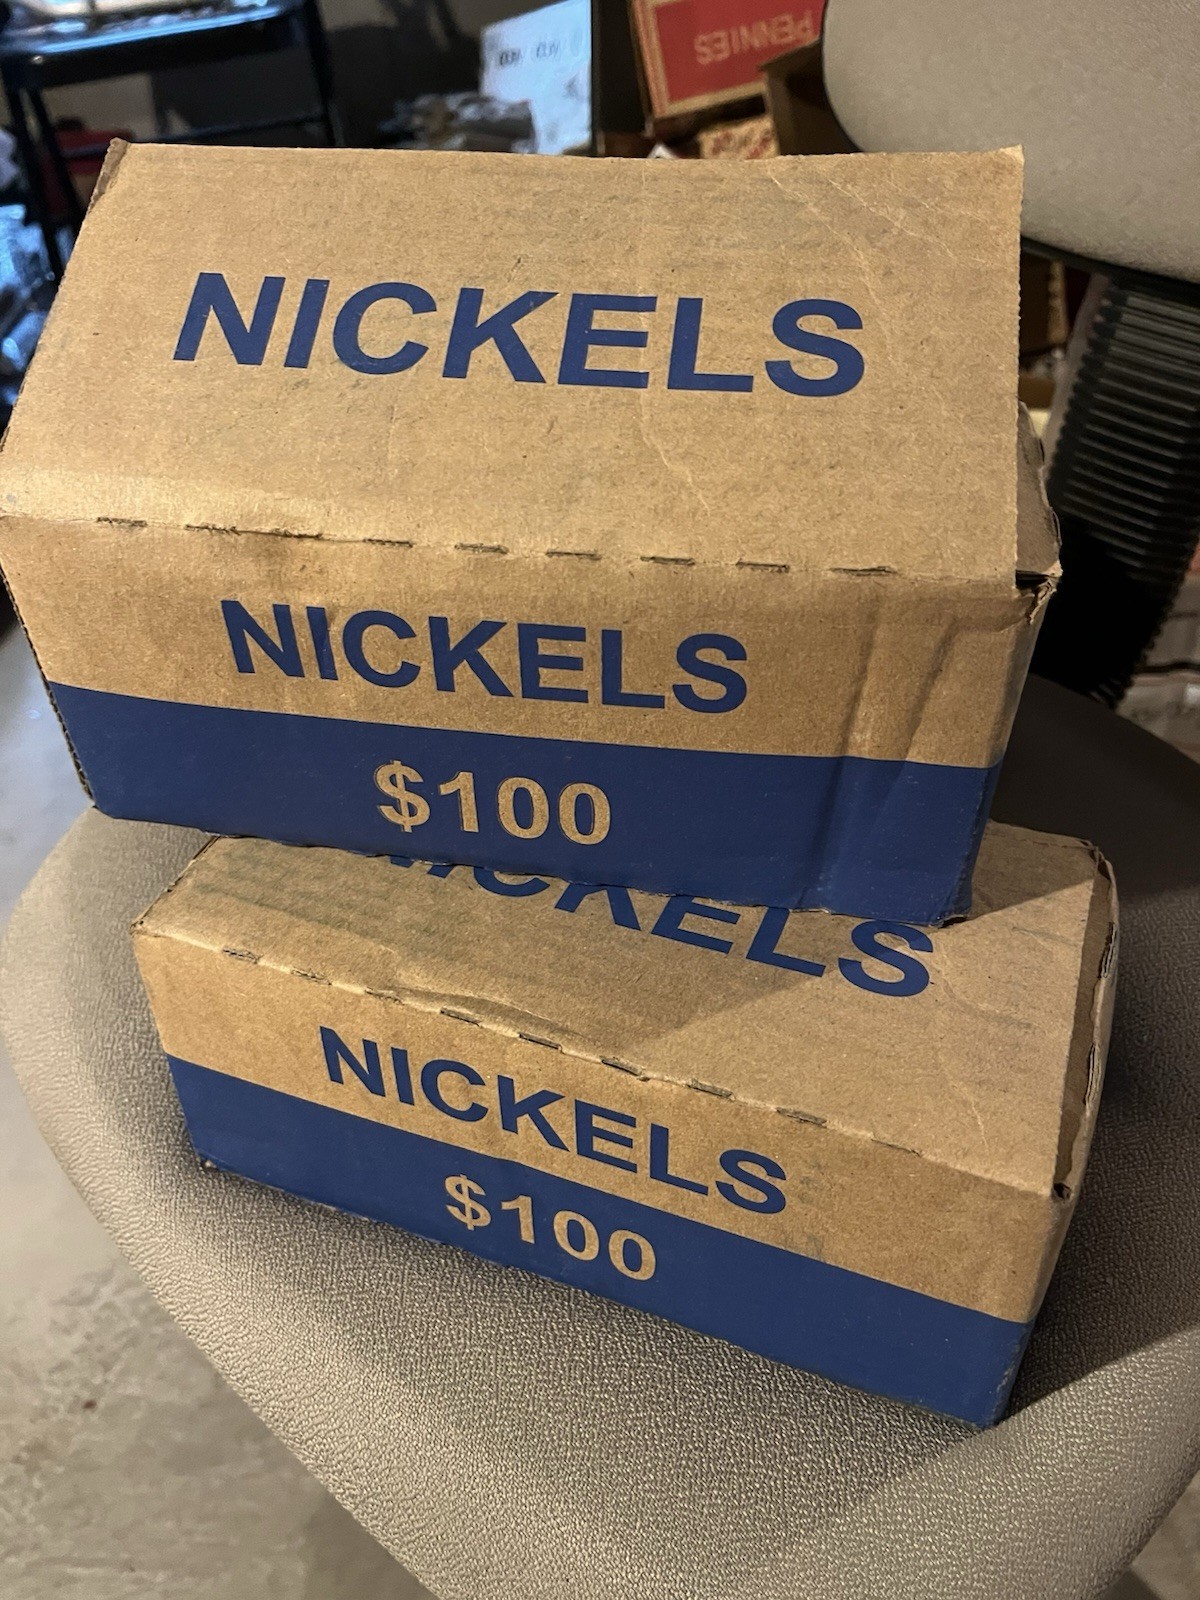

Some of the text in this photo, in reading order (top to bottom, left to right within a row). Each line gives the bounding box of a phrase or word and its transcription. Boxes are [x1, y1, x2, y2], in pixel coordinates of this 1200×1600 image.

[694, 10, 815, 65] PENNIES
[173, 272, 864, 397] NICKELS
[221, 600, 748, 713] NICKELS
[374, 760, 612, 846] $100
[320, 1026, 787, 1215] NICKELS
[442, 1172, 657, 1283] $100
